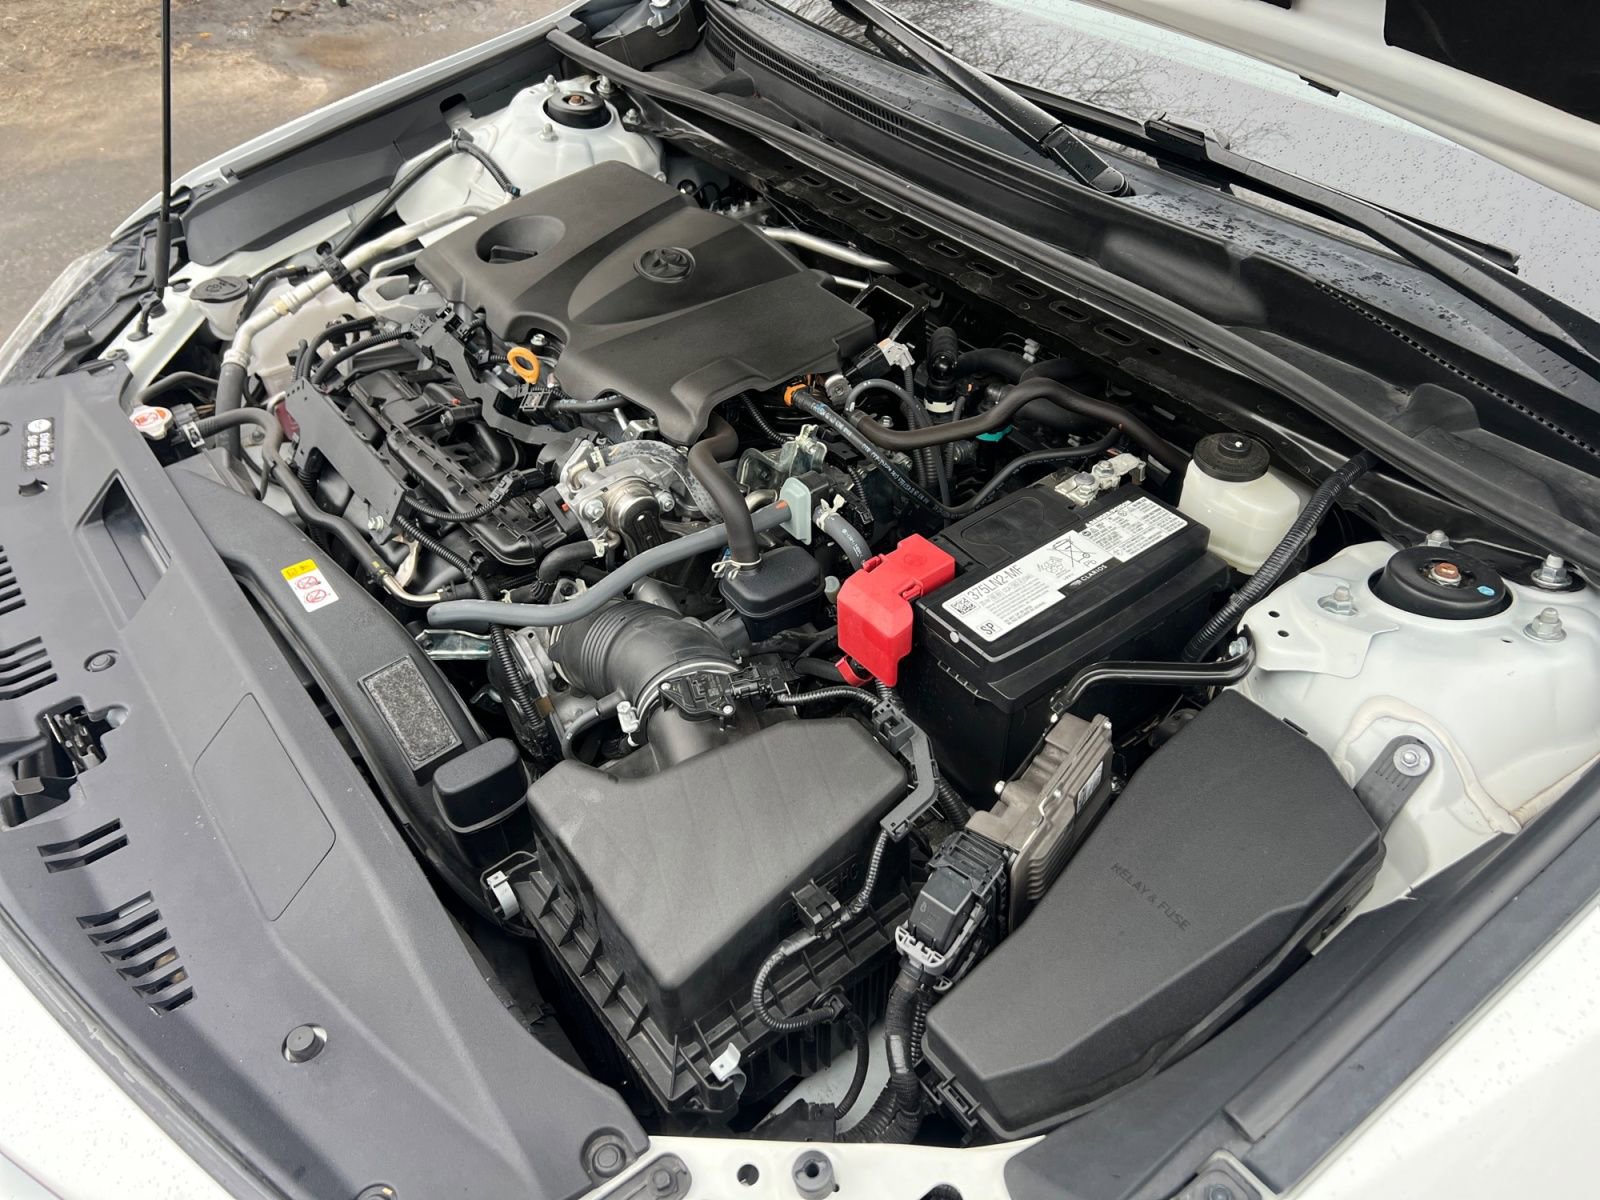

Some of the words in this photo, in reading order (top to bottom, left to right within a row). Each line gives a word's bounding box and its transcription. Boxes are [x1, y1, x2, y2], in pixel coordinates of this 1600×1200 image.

[1080, 564, 1108, 581] CLARIOS
[980, 622, 996, 635] SP
[1157, 901, 1192, 932] FUSE
